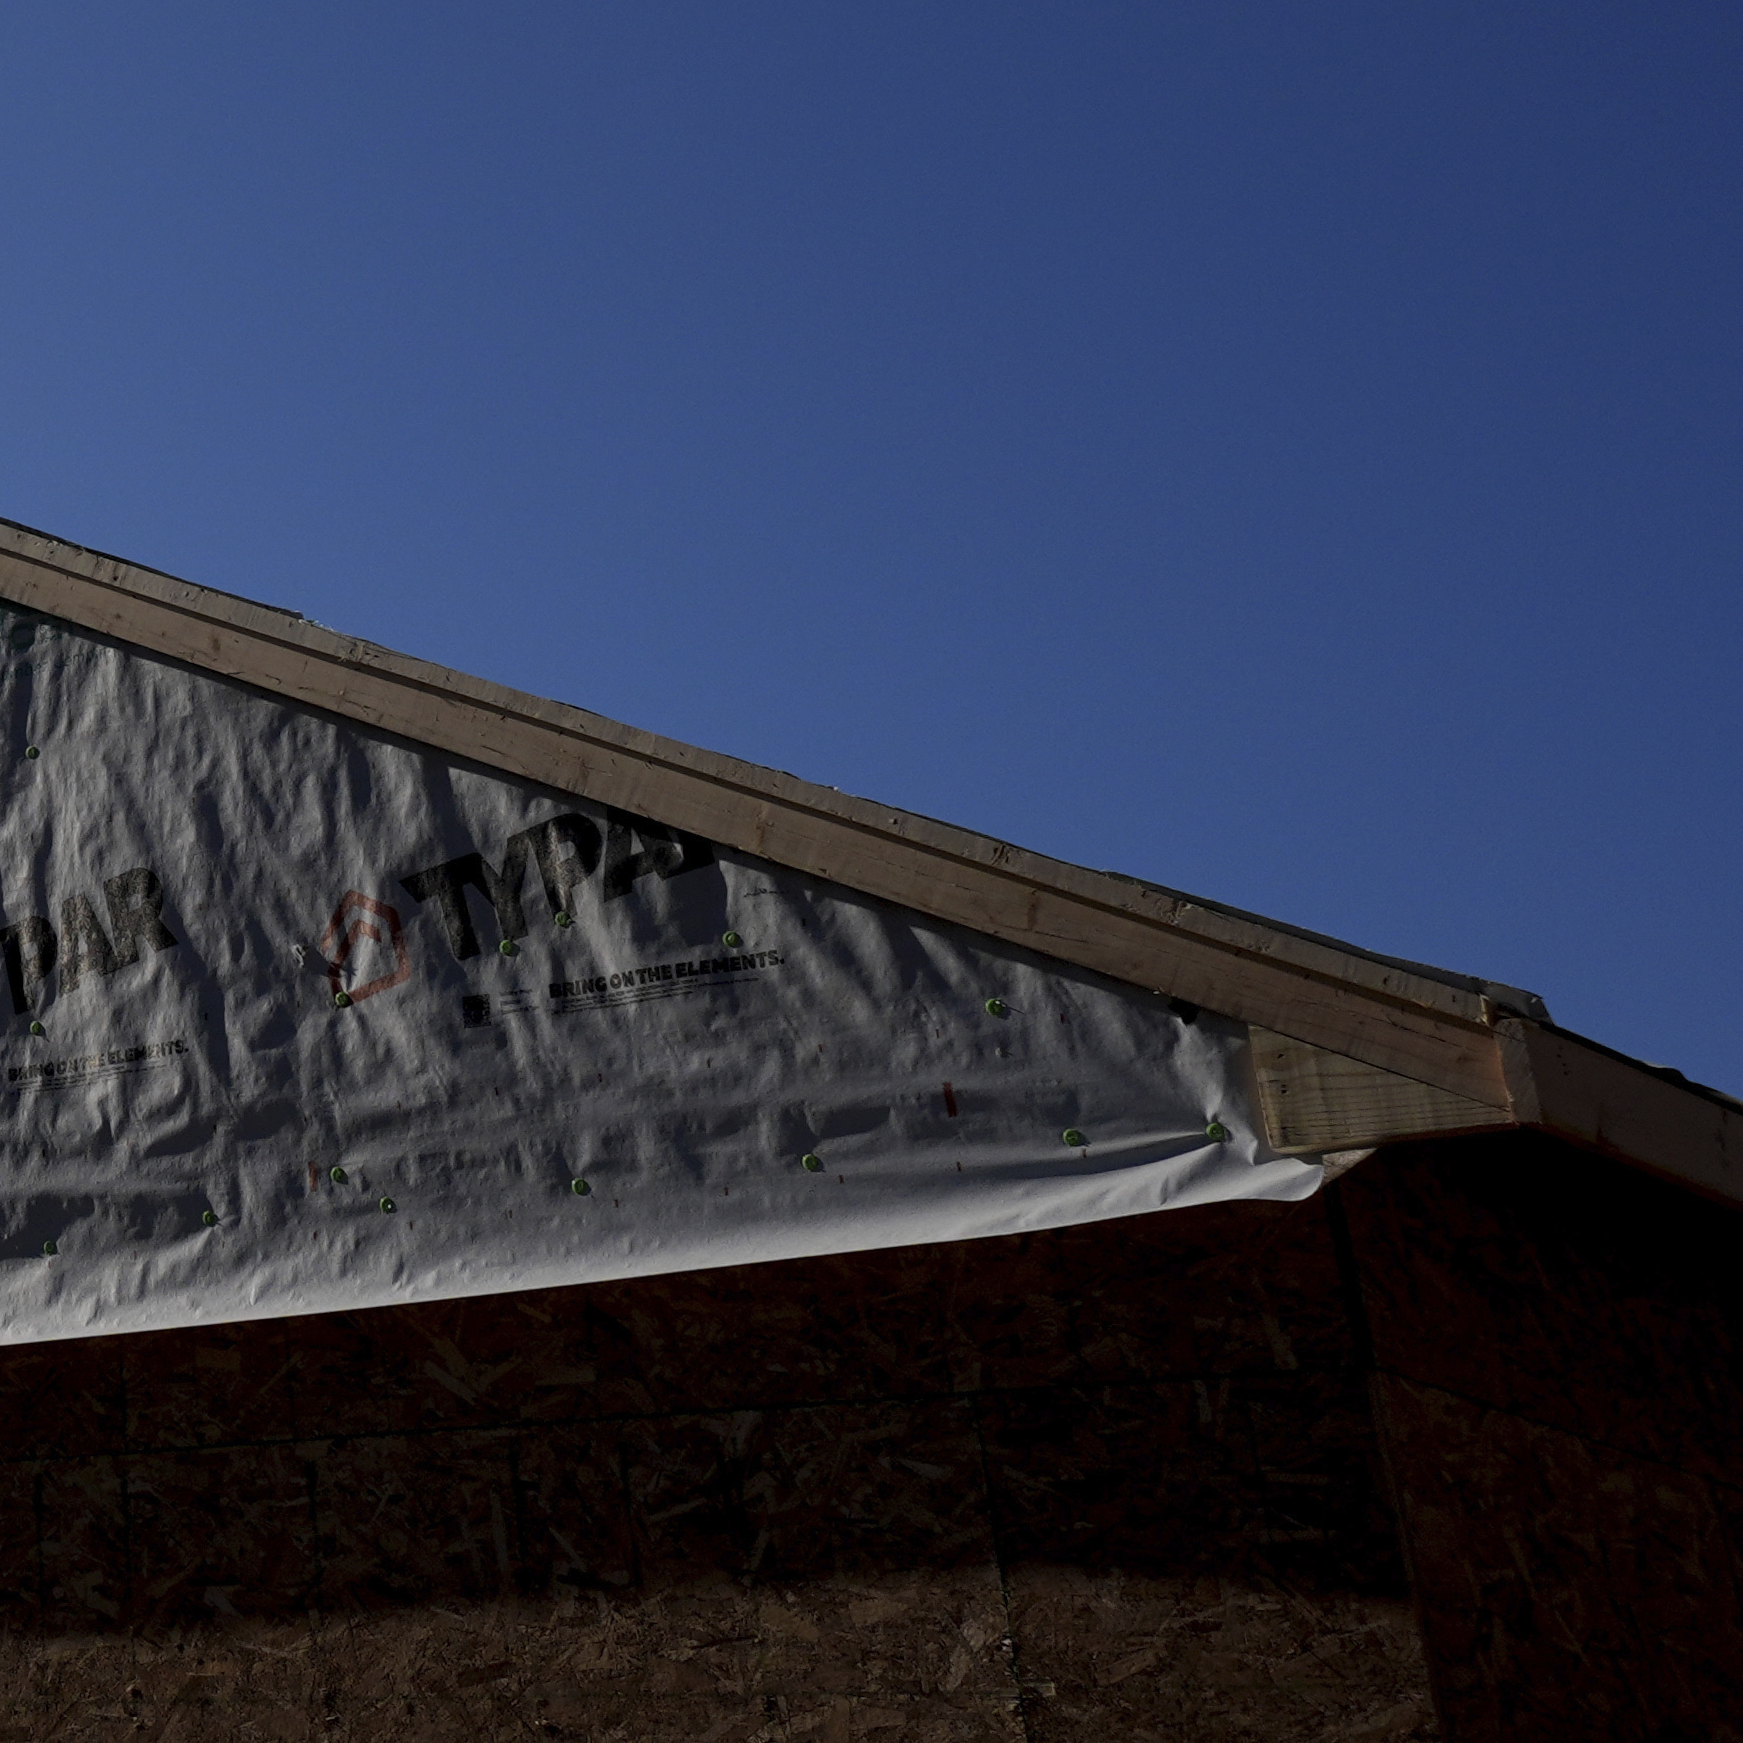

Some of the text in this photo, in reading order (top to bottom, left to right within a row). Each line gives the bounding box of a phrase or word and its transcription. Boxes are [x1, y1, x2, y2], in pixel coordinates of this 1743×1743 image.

[398, 805, 716, 960] TYPA
[548, 976, 607, 999] BRING
[609, 970, 635, 990] ON
[634, 964, 673, 985] THE
[675, 949, 786, 979] ELEMENTS.
